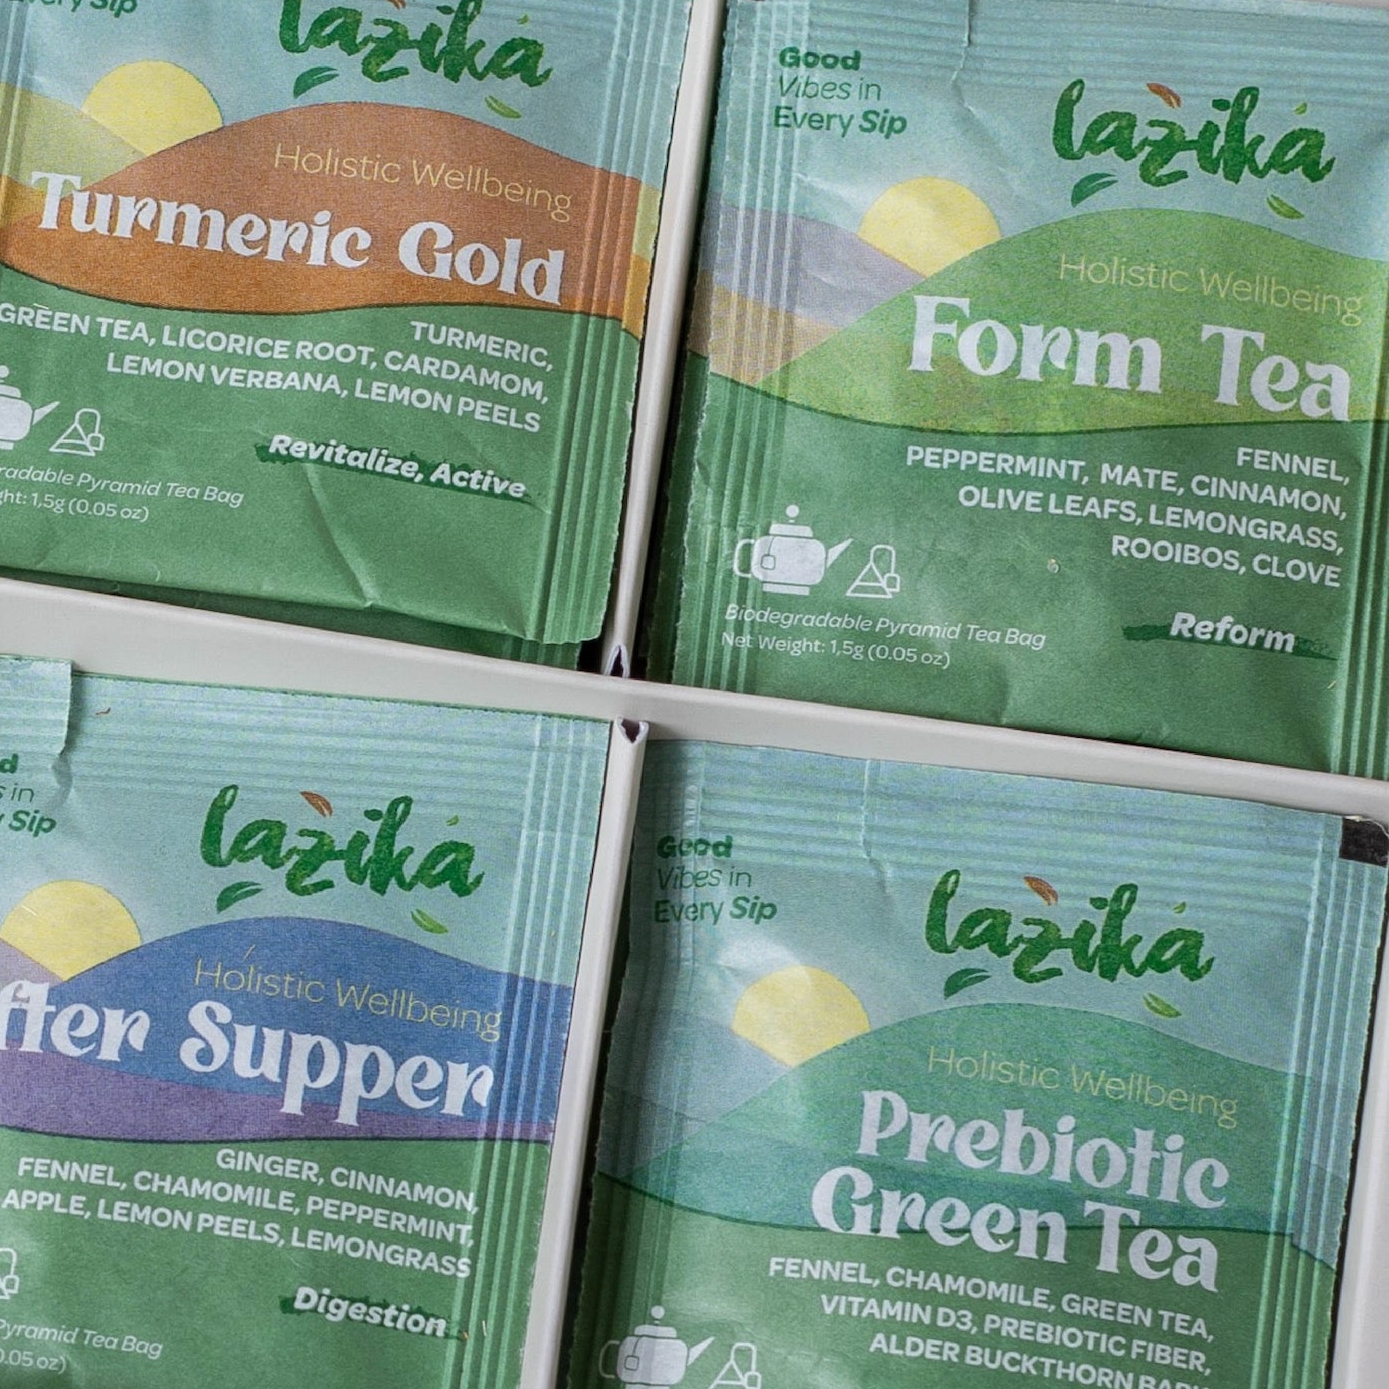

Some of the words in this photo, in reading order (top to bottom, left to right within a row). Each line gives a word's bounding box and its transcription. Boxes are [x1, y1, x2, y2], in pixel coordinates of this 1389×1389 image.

[779, 47, 861, 71] Good
[777, 75, 852, 100] Vibes
[859, 77, 881, 101] in
[774, 105, 854, 138] Every
[859, 110, 907, 139] Sip
[25, 171, 372, 268] Turmeric
[399, 221, 564, 305] Gold
[907, 295, 1162, 394] Form
[1201, 324, 1353, 422] Tea
[77, 473, 162, 496] Pyramid
[167, 483, 200, 499] Tea
[203, 486, 244, 508] Bag
[269, 435, 423, 482] Revitalize,
[430, 463, 526, 497] Active
[907, 446, 1088, 485] PEPPERMINT,
[1101, 463, 1184, 495] MATE,
[1191, 475, 1346, 520] CINNAMON,
[1237, 447, 1349, 485] FENNEL,
[32, 494, 66, 516] 1,5g
[68, 498, 117, 517] (0.05
[120, 506, 149, 522] oz)
[959, 486, 1043, 512] OLIVE
[1049, 493, 1142, 525] LEAFS,
[1149, 504, 1343, 555] LEMONGRASS,
[1112, 535, 1246, 575] ROOIBOS,
[1252, 554, 1341, 587] CLOVE
[1170, 612, 1295, 652] Reform
[180, 1000, 494, 1127] Supper
[856, 1090, 1229, 1208] Prebiotic
[811, 1166, 1066, 1263] Green
[1084, 1201, 1218, 1292] Tea
[294, 1287, 446, 1337] Digestion
